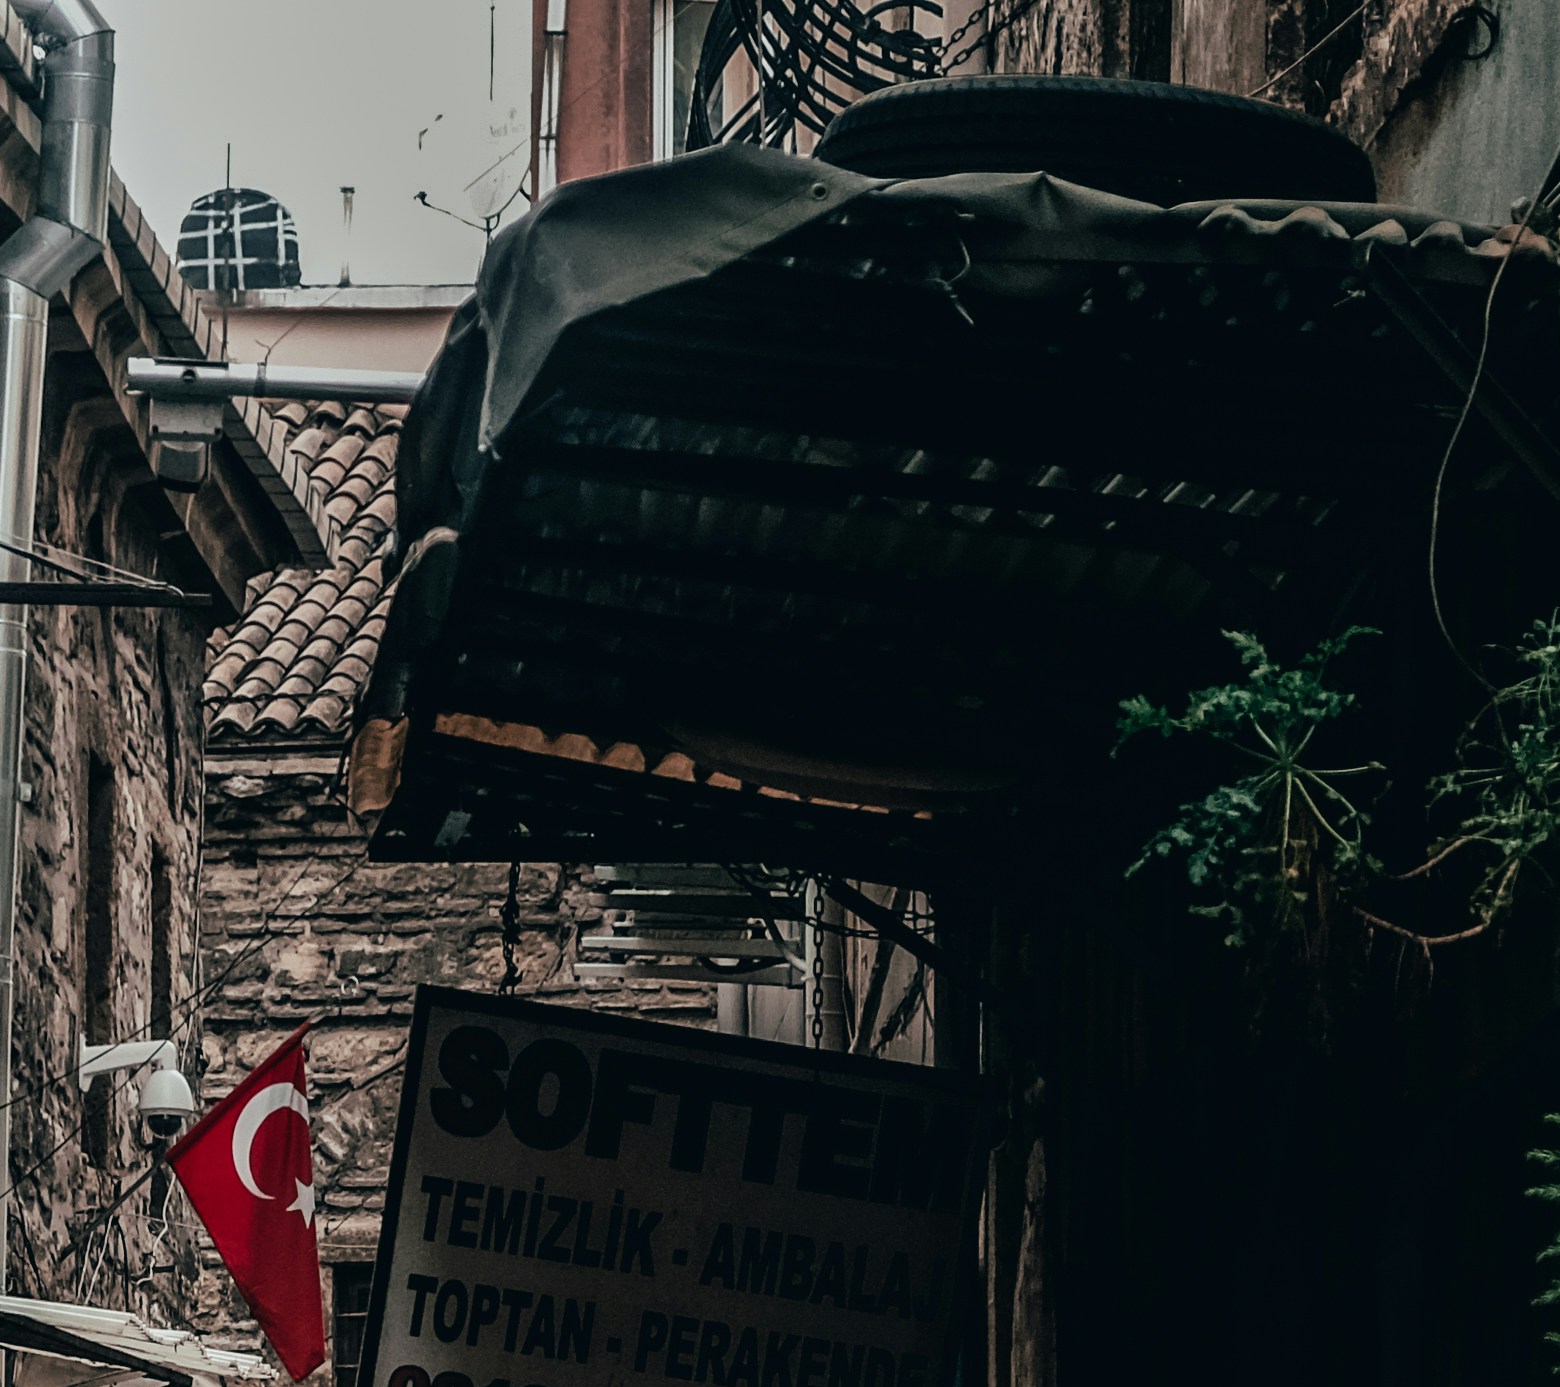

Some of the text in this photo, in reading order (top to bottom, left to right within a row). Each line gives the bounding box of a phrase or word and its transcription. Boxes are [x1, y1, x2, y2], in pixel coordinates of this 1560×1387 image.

[430, 1026, 972, 1212] SOFTTEM
[406, 1274, 596, 1364] TOPTAN
[421, 1176, 663, 1276] TEMİZLİK
[700, 1223, 947, 1322] AMBALAJ
